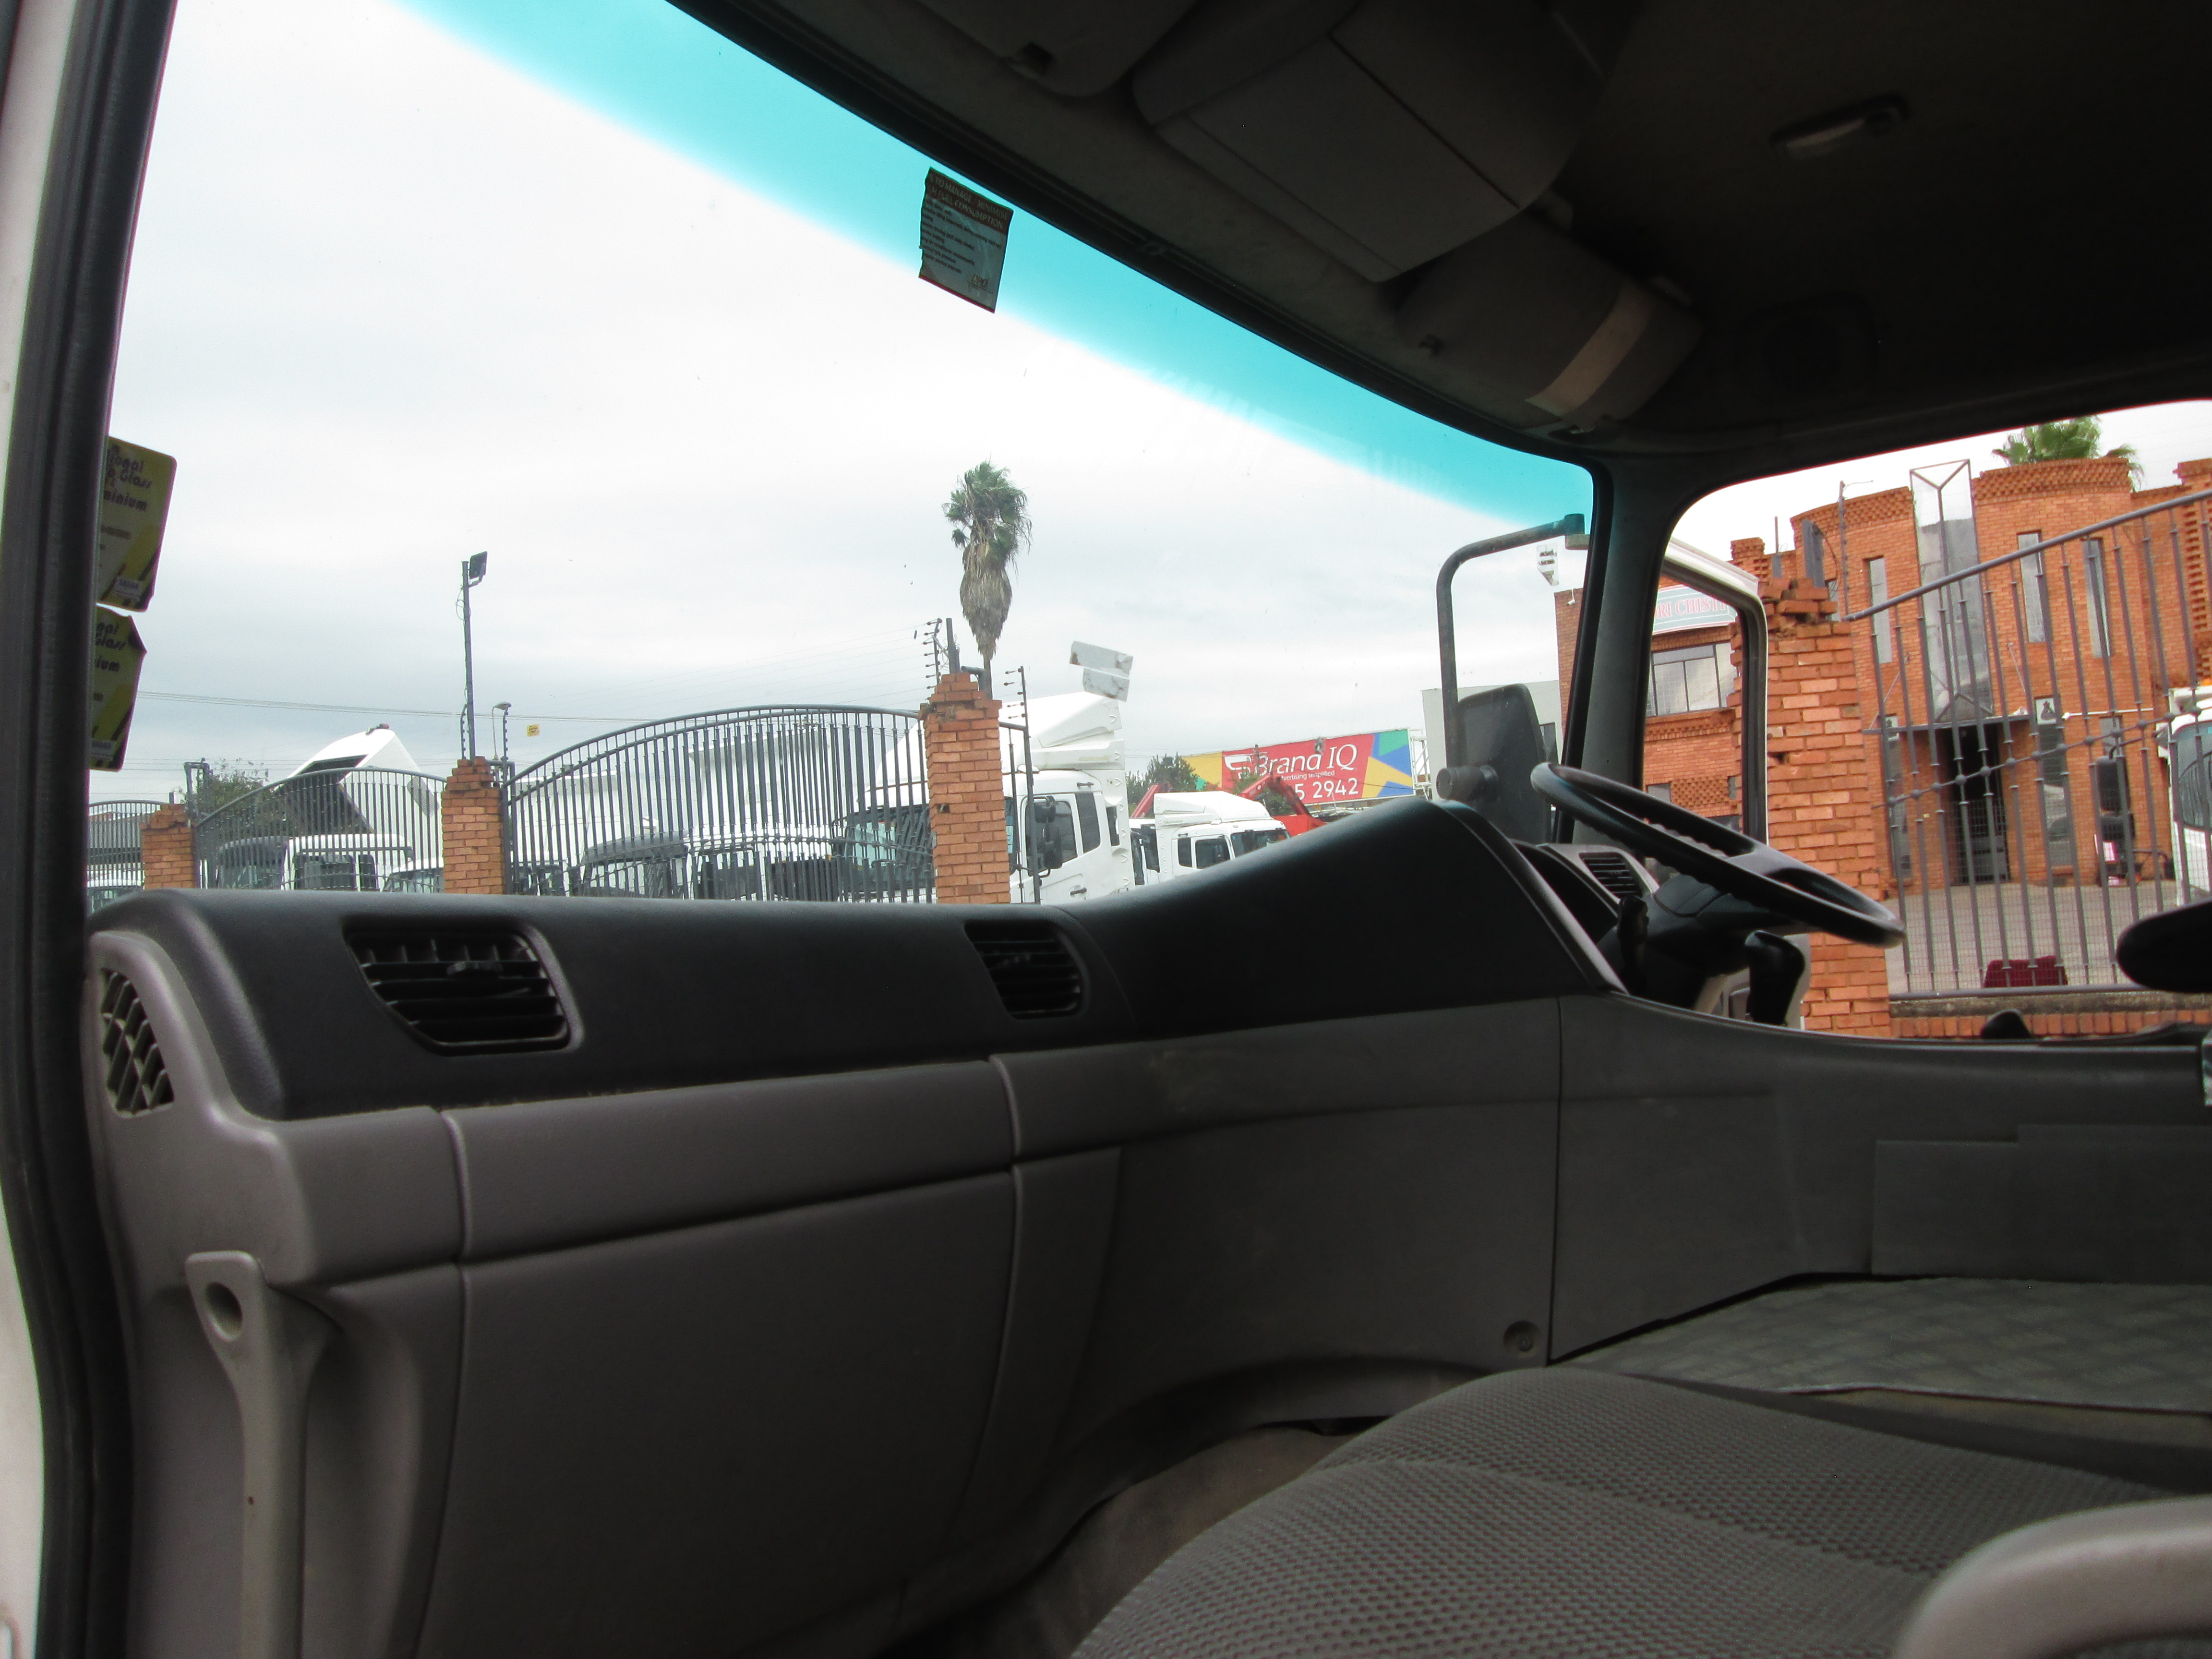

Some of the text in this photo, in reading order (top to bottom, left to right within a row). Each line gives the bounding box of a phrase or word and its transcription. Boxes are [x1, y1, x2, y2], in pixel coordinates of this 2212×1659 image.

[945, 183, 973, 204] MANAGE
[955, 200, 1004, 229] CONSUMPTION
[1326, 744, 1358, 770] IQ
[1308, 770, 1335, 779] simplified
[1312, 777, 1359, 799] 2942
